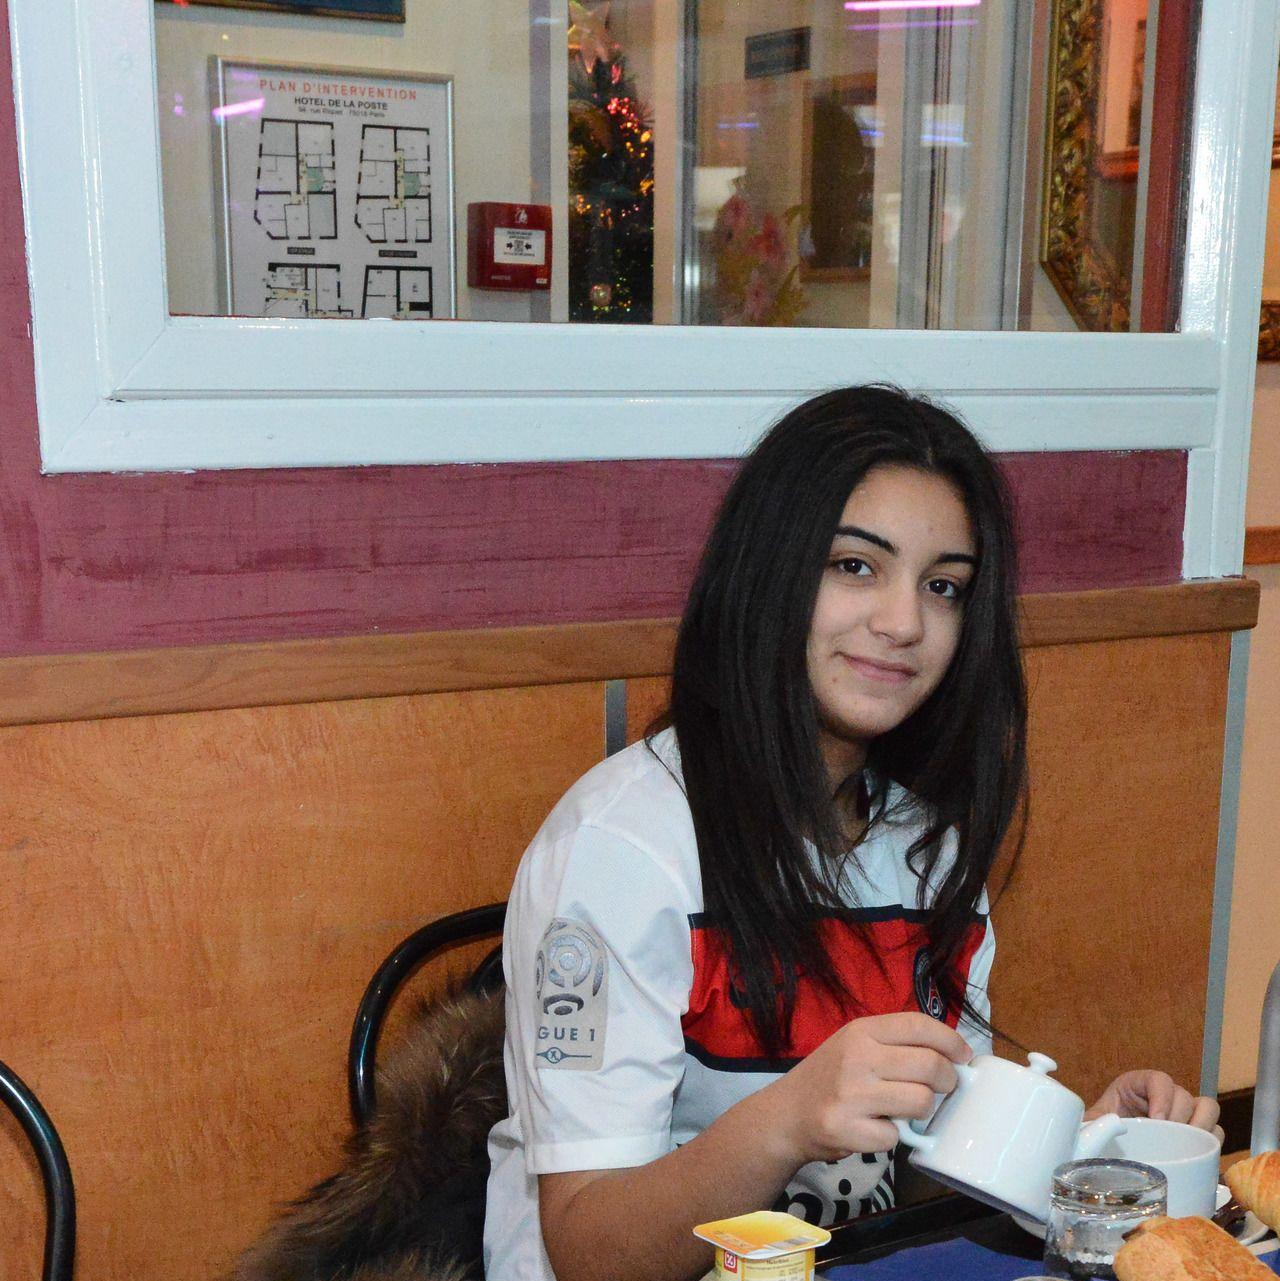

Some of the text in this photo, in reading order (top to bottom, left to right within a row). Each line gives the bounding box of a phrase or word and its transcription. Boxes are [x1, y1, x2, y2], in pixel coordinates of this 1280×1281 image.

[259, 80, 417, 100] PLAN D'INTERVENTION
[328, 99, 341, 107] DE
[343, 100, 355, 108] LA
[358, 101, 388, 110] POSTE
[538, 1026, 596, 1041] GUE 1
